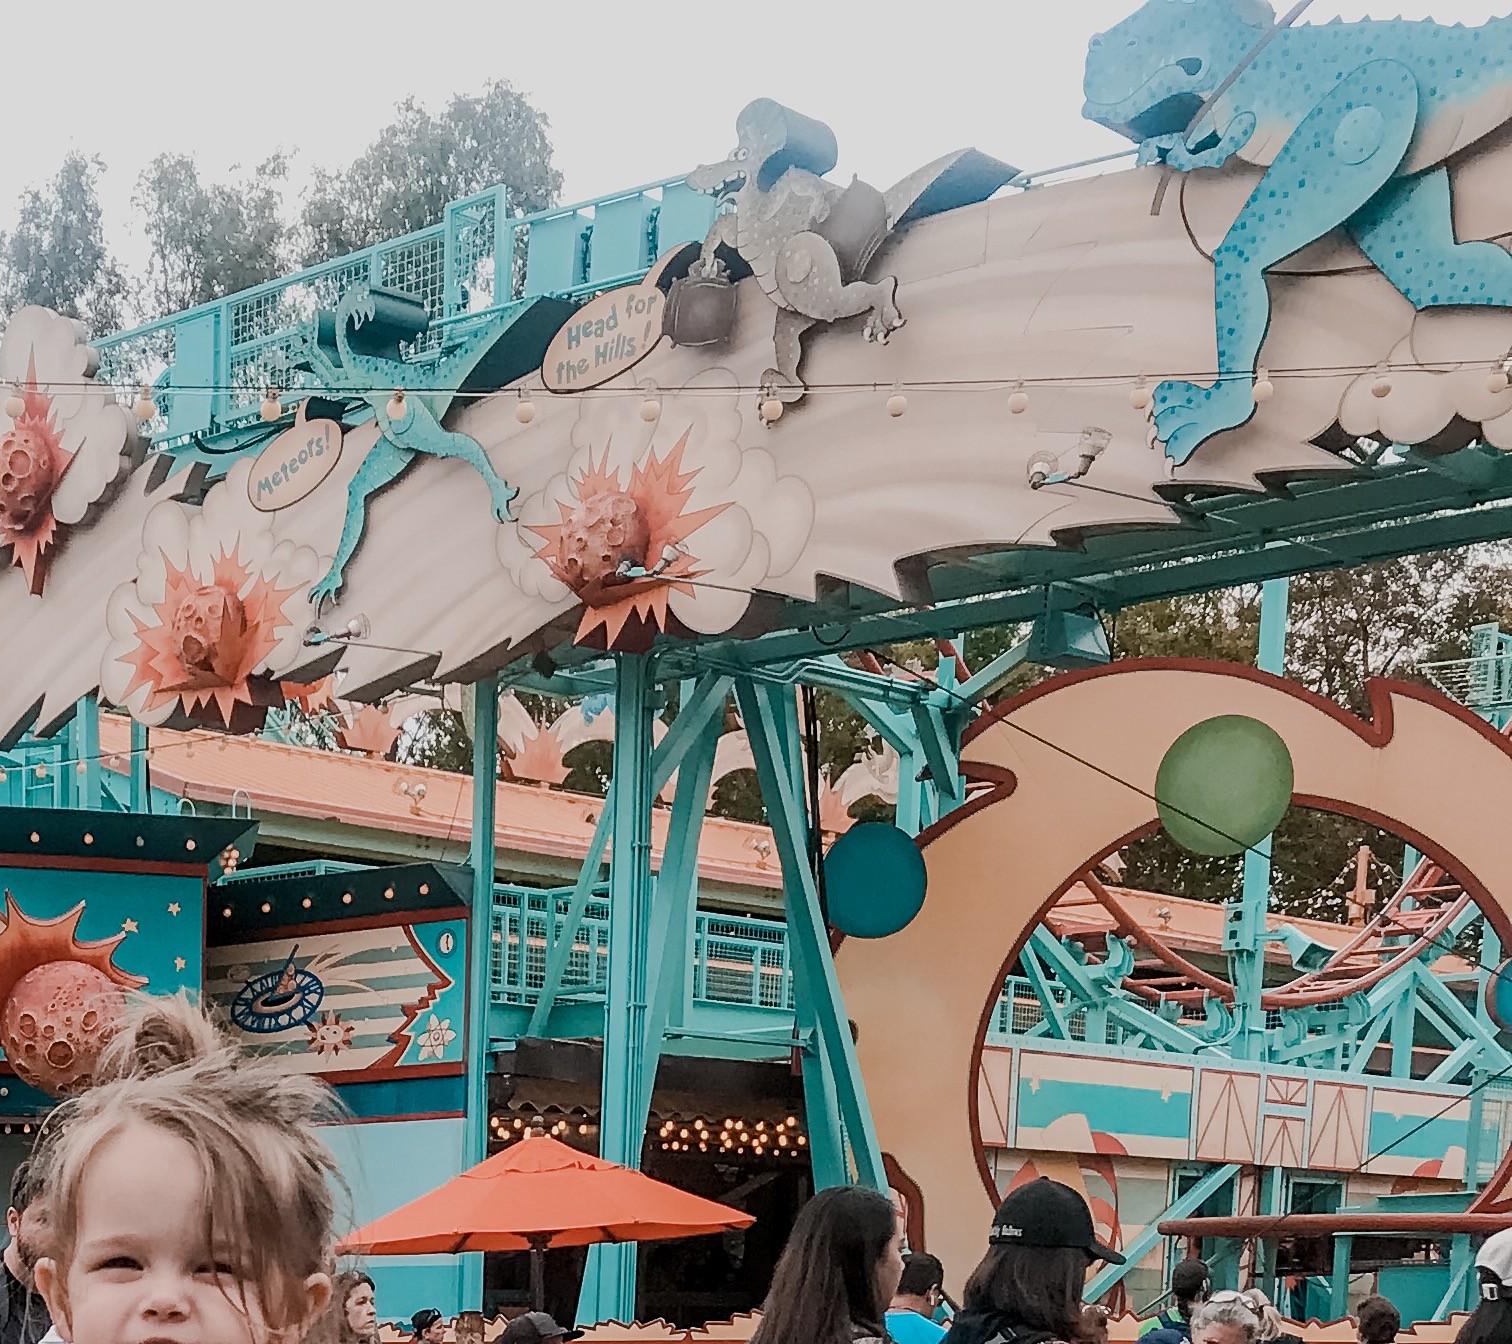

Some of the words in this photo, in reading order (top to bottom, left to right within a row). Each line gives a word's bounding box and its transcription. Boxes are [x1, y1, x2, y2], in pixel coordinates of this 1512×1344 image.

[567, 303, 618, 350] Head
[625, 293, 657, 318] for
[556, 356, 590, 385] the
[257, 423, 330, 501] Meteors!
